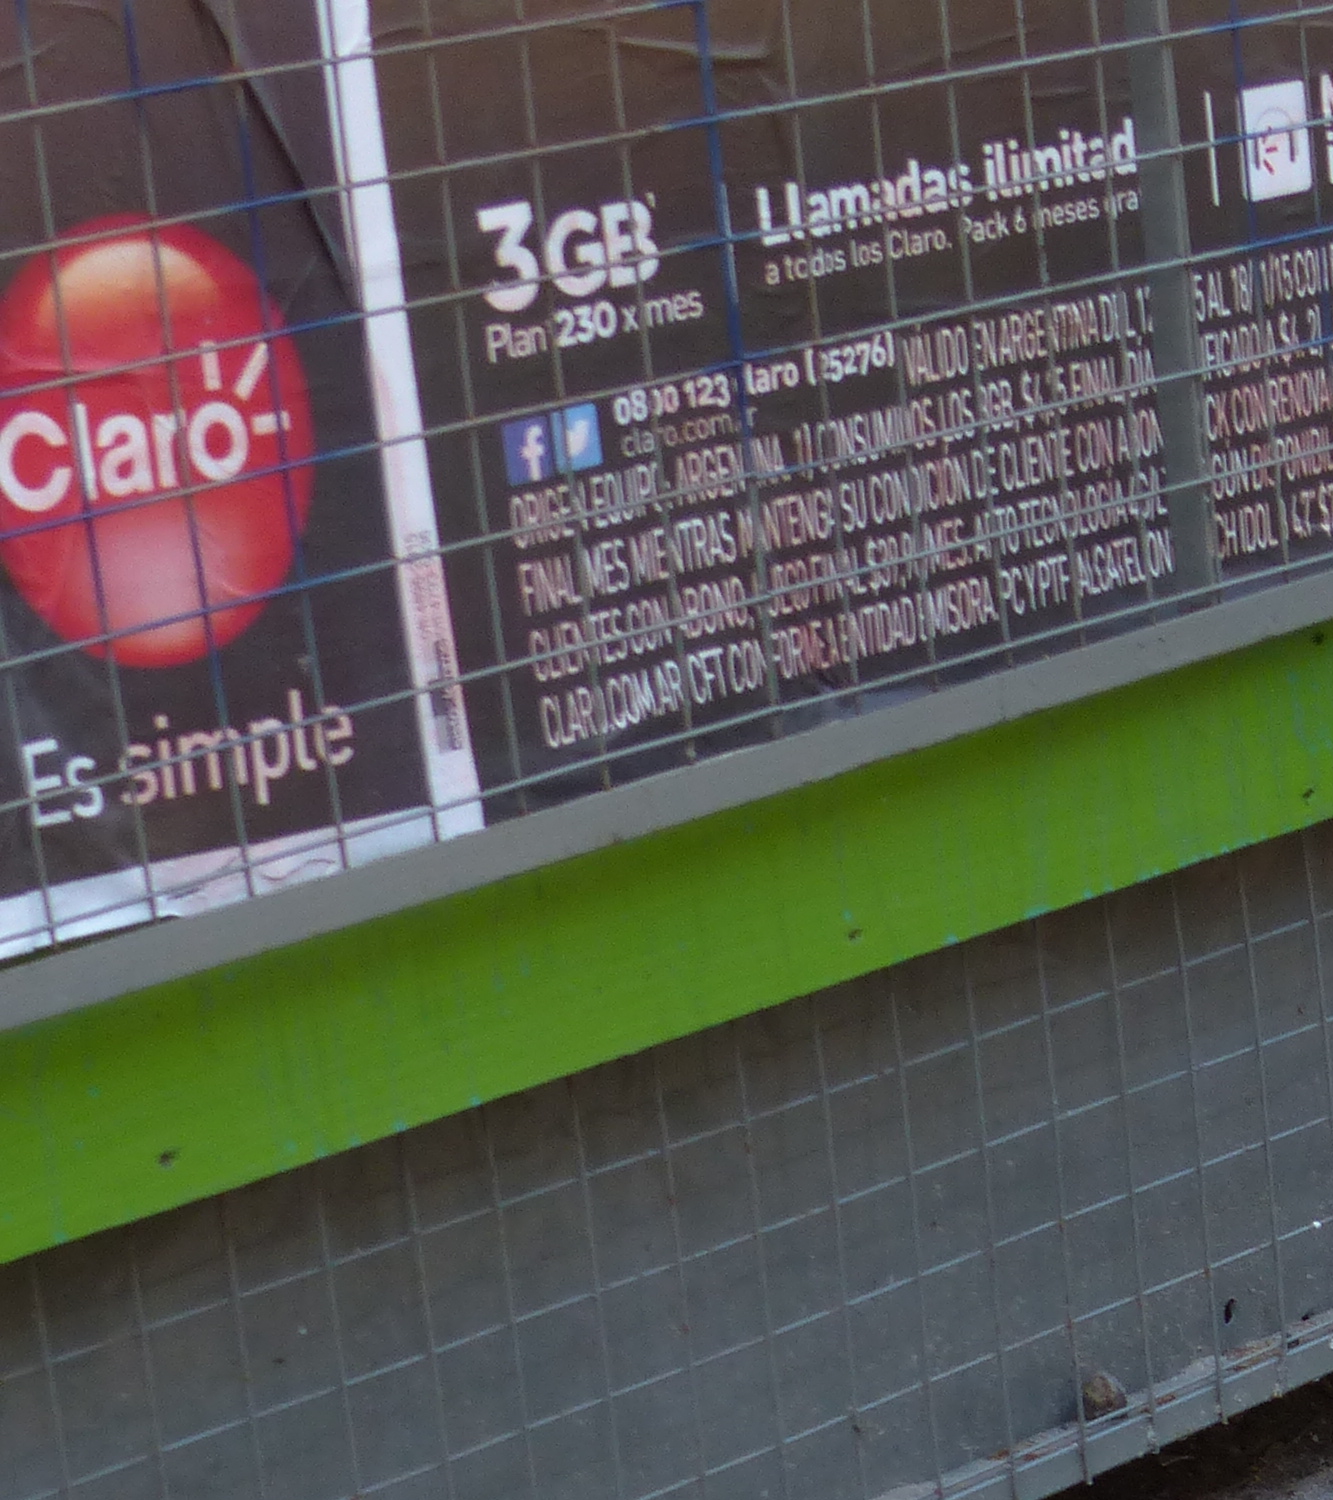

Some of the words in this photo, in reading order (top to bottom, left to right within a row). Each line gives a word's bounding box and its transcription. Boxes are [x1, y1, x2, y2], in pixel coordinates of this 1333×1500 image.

[755, 157, 974, 247] Llamadas
[764, 261, 781, 285] a
[850, 237, 884, 268] los
[485, 321, 548, 363] Plan
[553, 300, 619, 348] 230
[643, 290, 704, 331] mes
[0, 401, 249, 512] Claro
[20, 737, 104, 828] Es
[118, 688, 355, 806] simple
